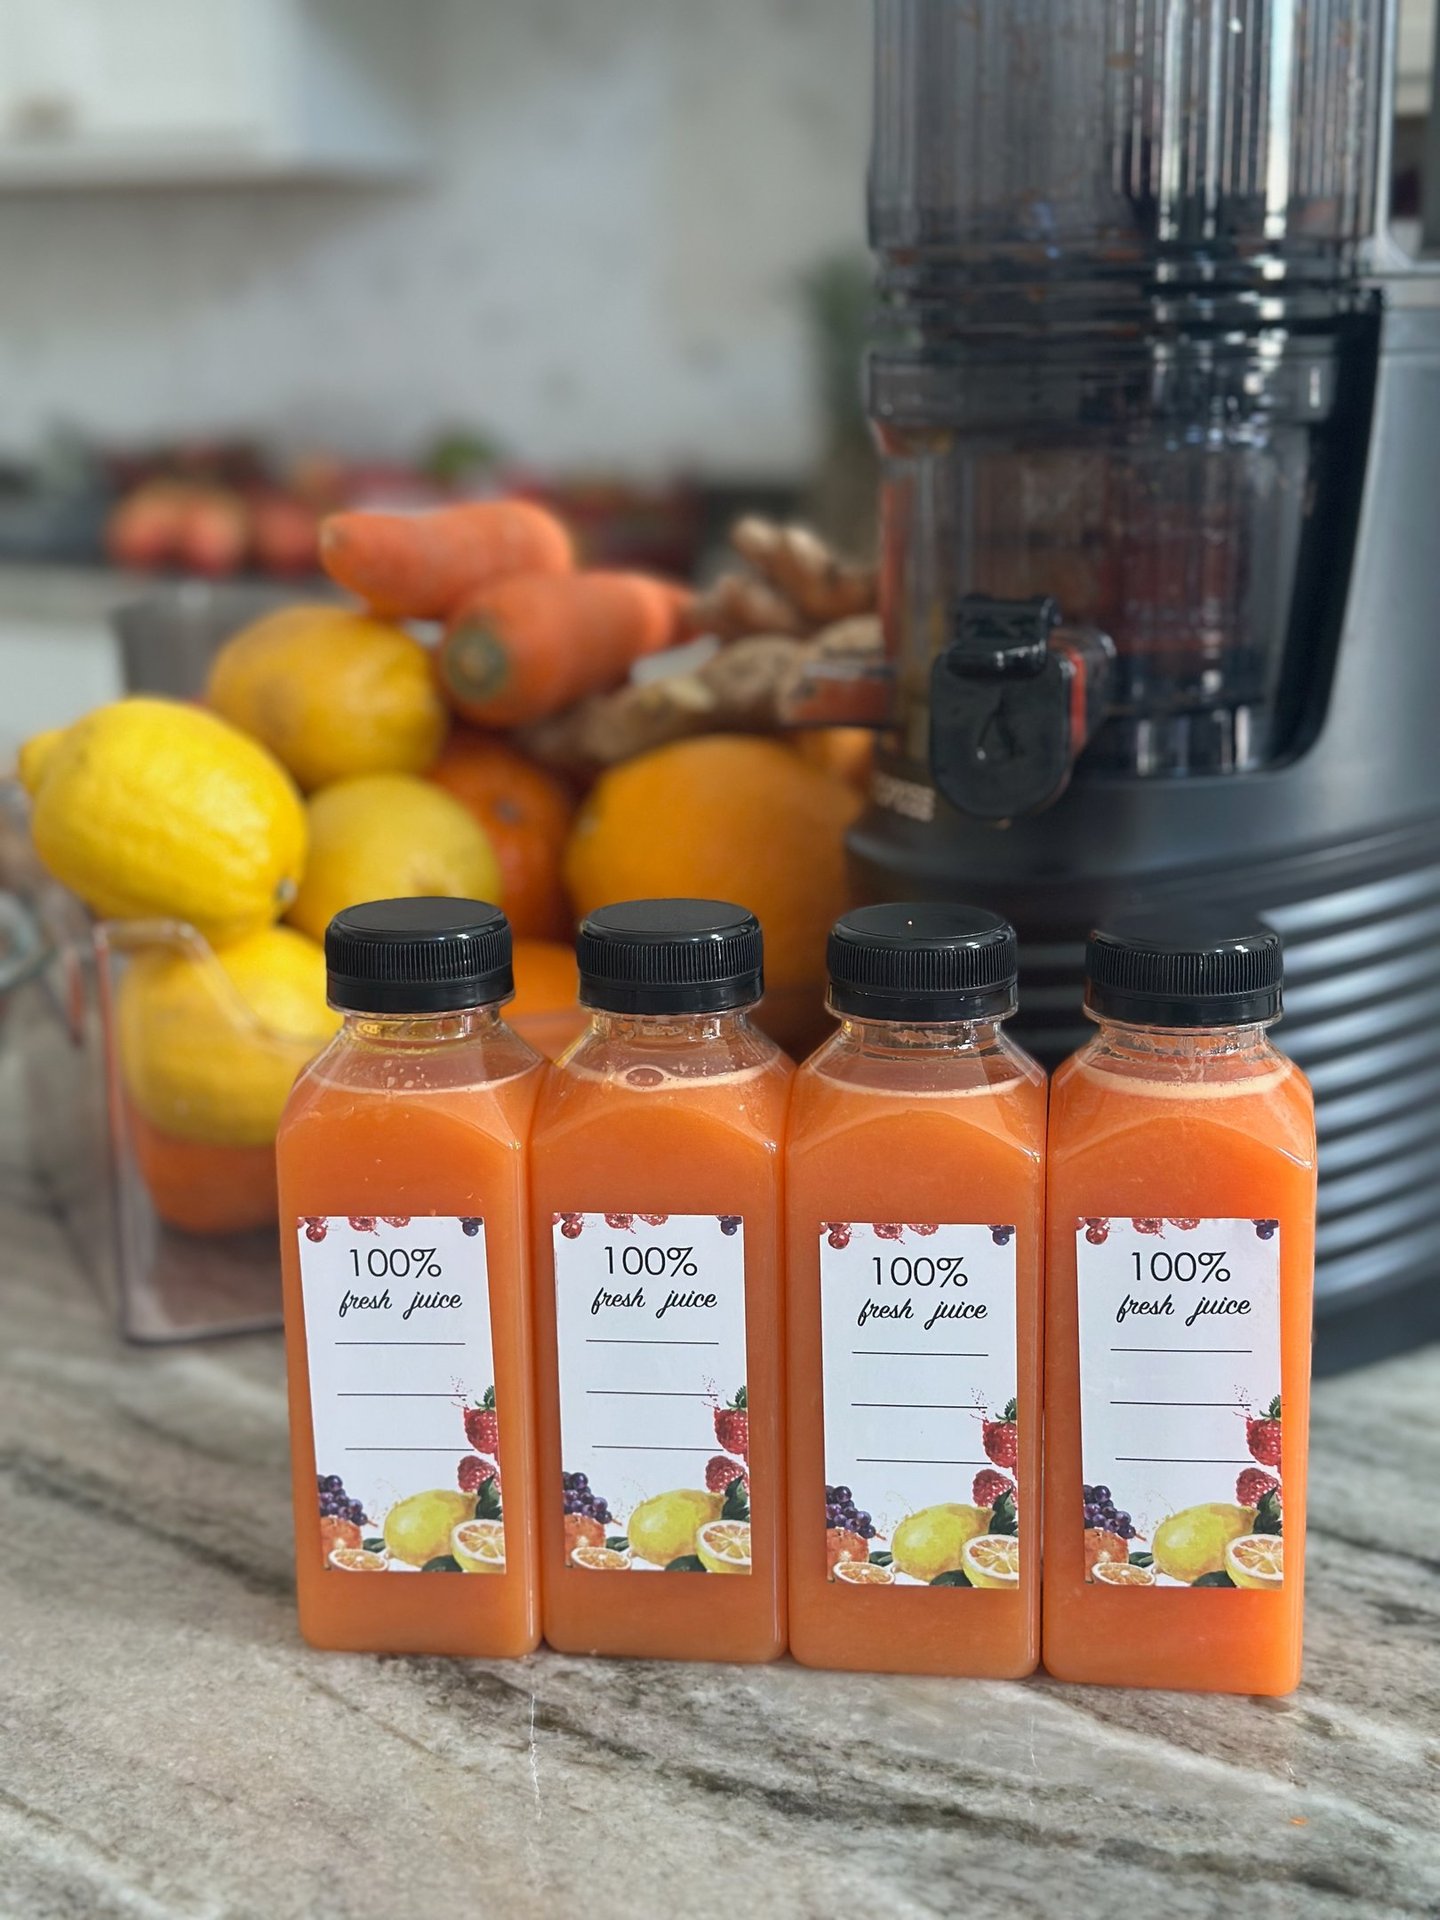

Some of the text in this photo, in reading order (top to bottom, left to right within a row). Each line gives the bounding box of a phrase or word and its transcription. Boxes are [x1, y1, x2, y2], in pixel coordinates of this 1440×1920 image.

[349, 1247, 442, 1279] 100%
[604, 1246, 698, 1278] 100%
[872, 1256, 969, 1288] 100%
[1131, 1251, 1231, 1284] 100%
[338, 1288, 463, 1321] fresh juice
[590, 1286, 718, 1319] fresh juice
[857, 1297, 988, 1331] fresh juice
[1115, 1293, 1252, 1327] fresh juice
